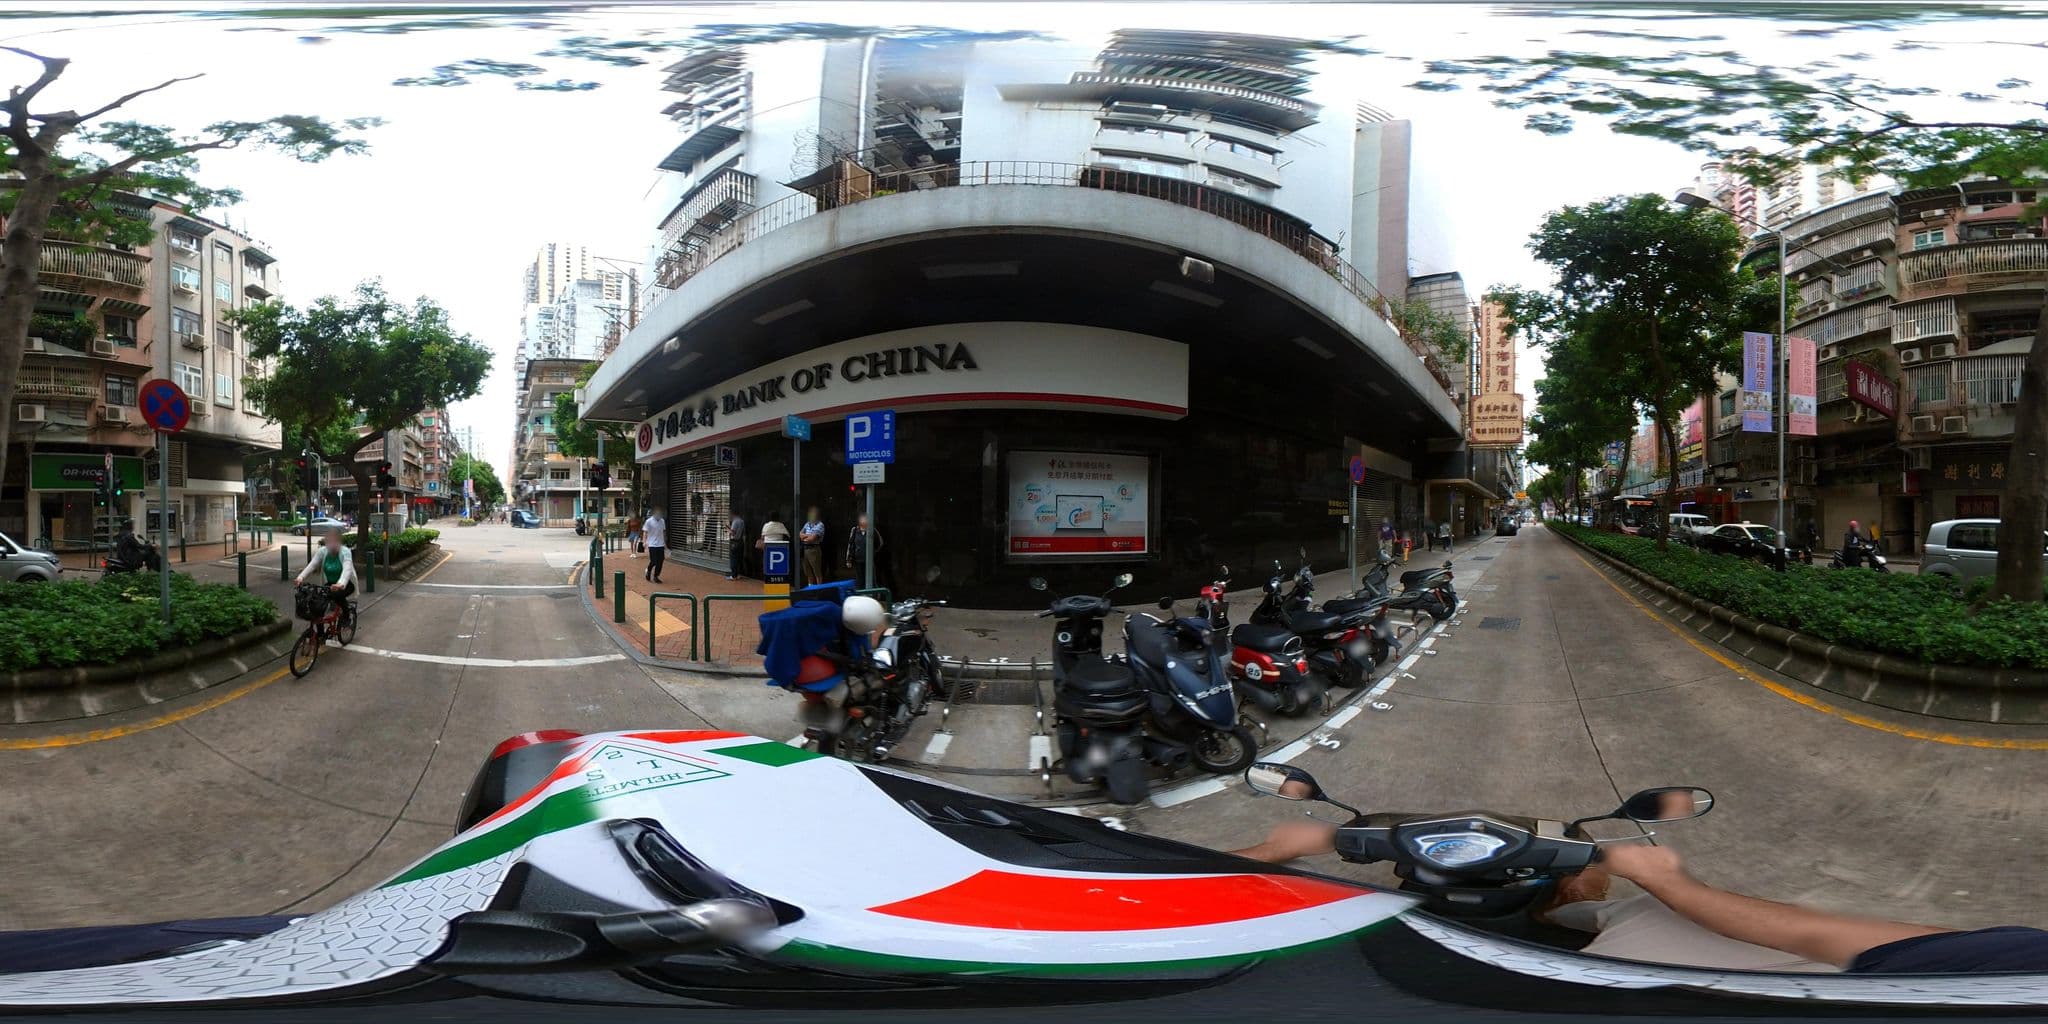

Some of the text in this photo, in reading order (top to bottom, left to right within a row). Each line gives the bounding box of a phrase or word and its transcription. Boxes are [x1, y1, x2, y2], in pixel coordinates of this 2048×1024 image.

[722, 342, 978, 414] BANK OF CHINA
[655, 397, 718, 444] 中國銀行
[849, 416, 871, 451] P
[849, 449, 891, 459] MOTOCICLOS
[770, 551, 785, 570] P
[578, 772, 683, 799] HELMETS
